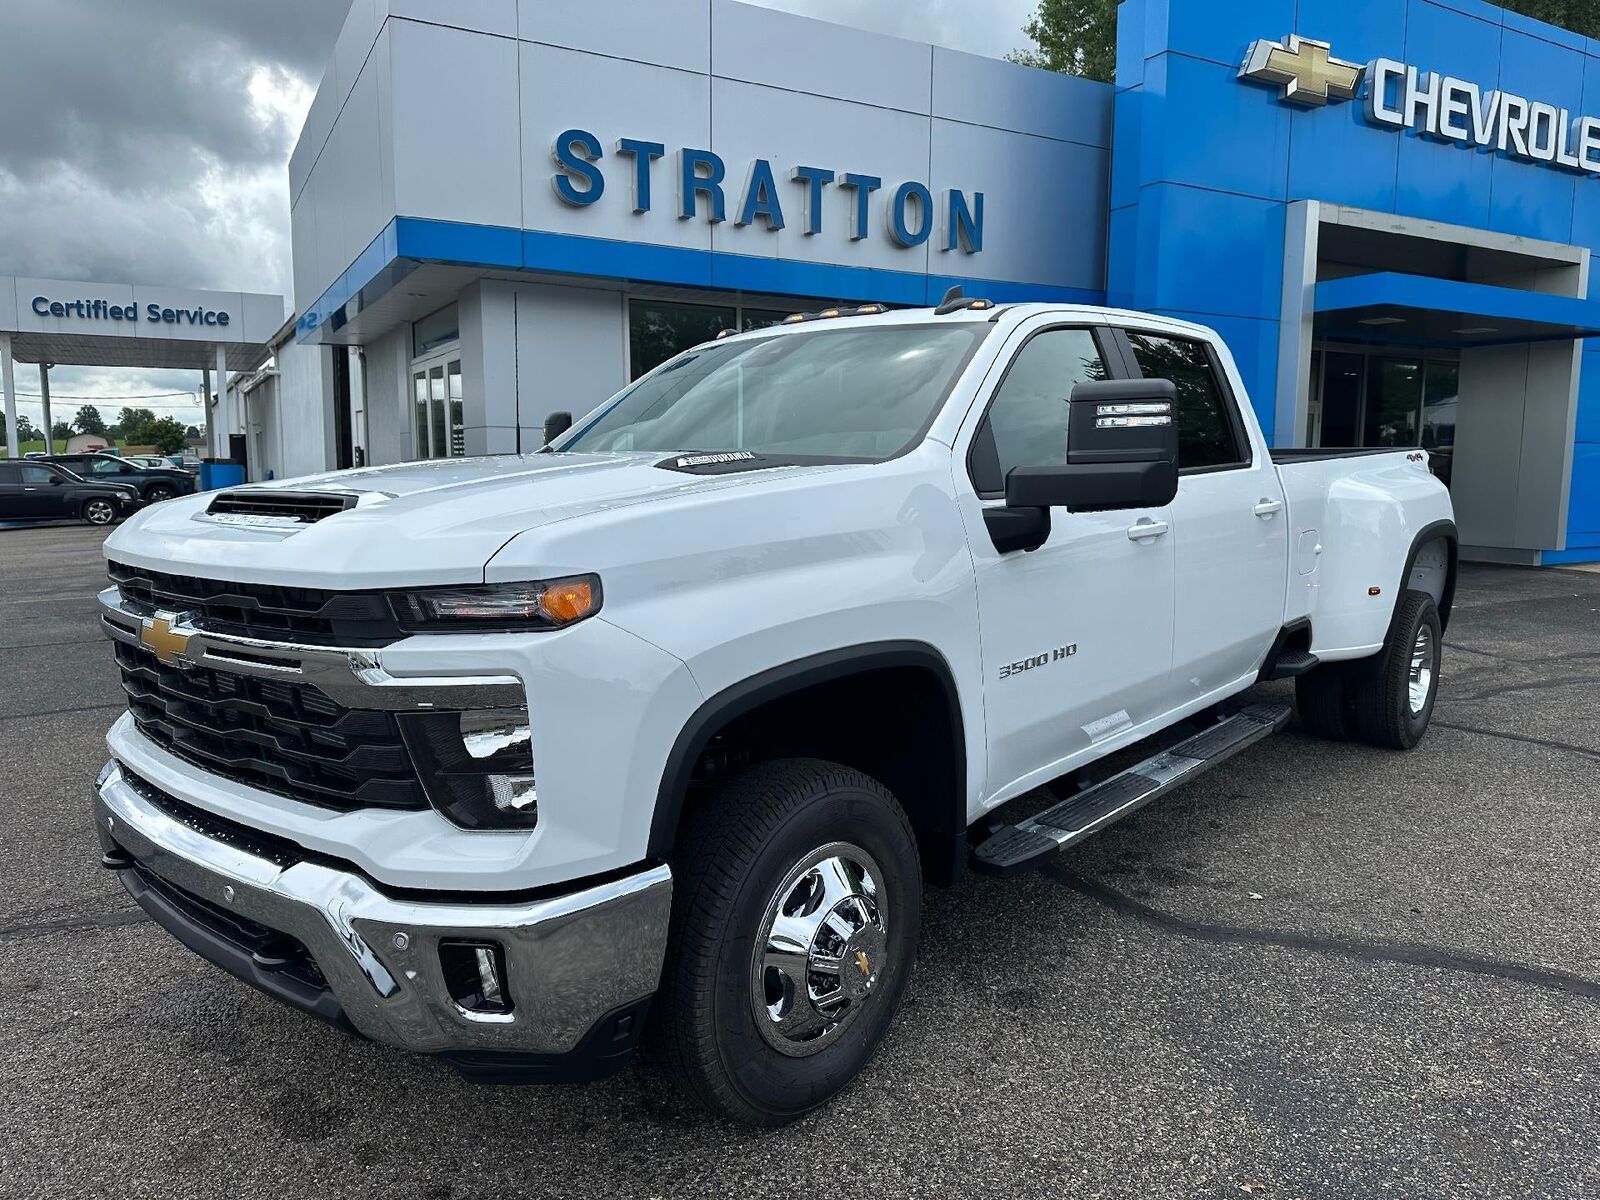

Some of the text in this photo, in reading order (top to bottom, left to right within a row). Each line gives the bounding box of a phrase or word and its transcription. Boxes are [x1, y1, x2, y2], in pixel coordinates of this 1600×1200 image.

[551, 129, 985, 255] STRATTON
[31, 295, 230, 326] Certified Service
[710, 451, 755, 464] DURAMAX
[999, 643, 1077, 680] 3500 HD
